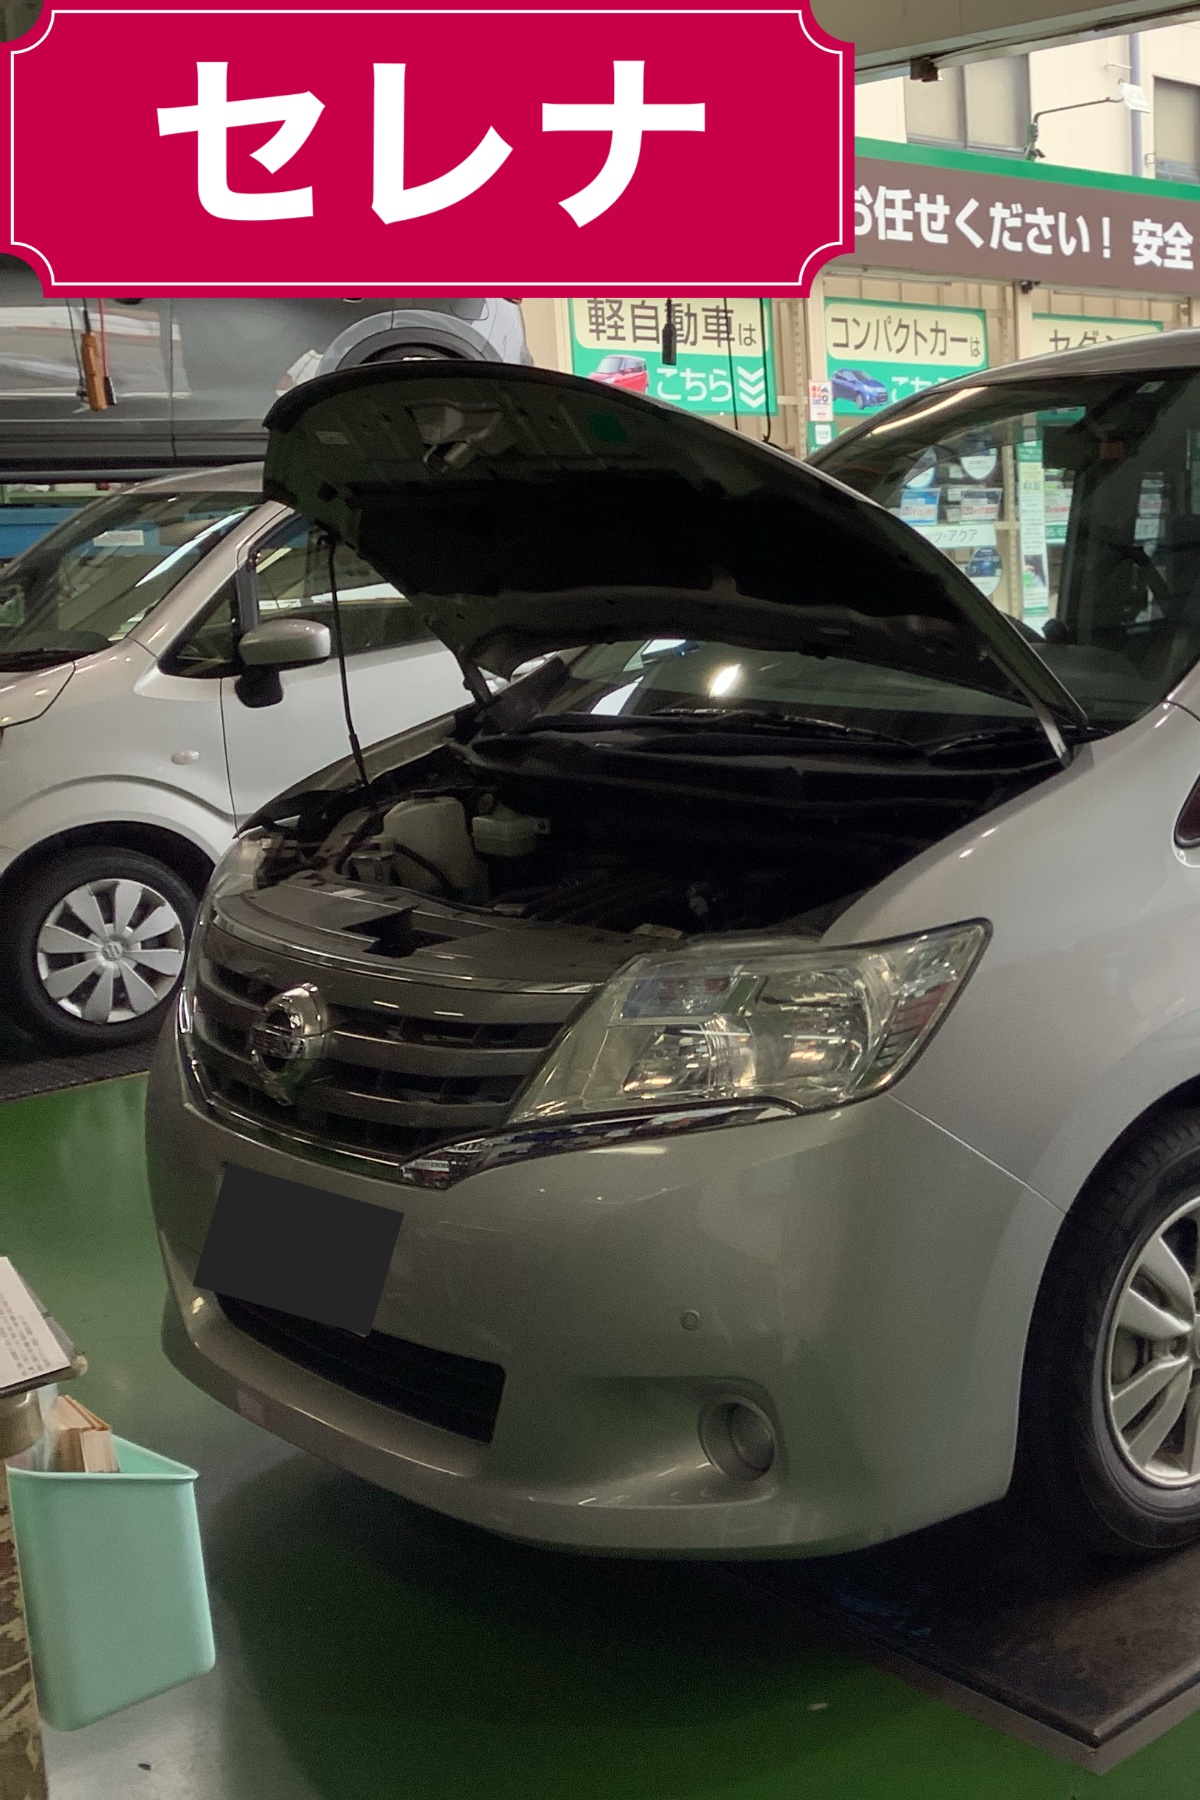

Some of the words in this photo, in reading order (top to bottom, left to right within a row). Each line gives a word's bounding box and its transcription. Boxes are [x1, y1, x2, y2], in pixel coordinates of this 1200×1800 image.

[831, 315, 982, 357] コンパクトカーは
[656, 366, 733, 402] こちら
